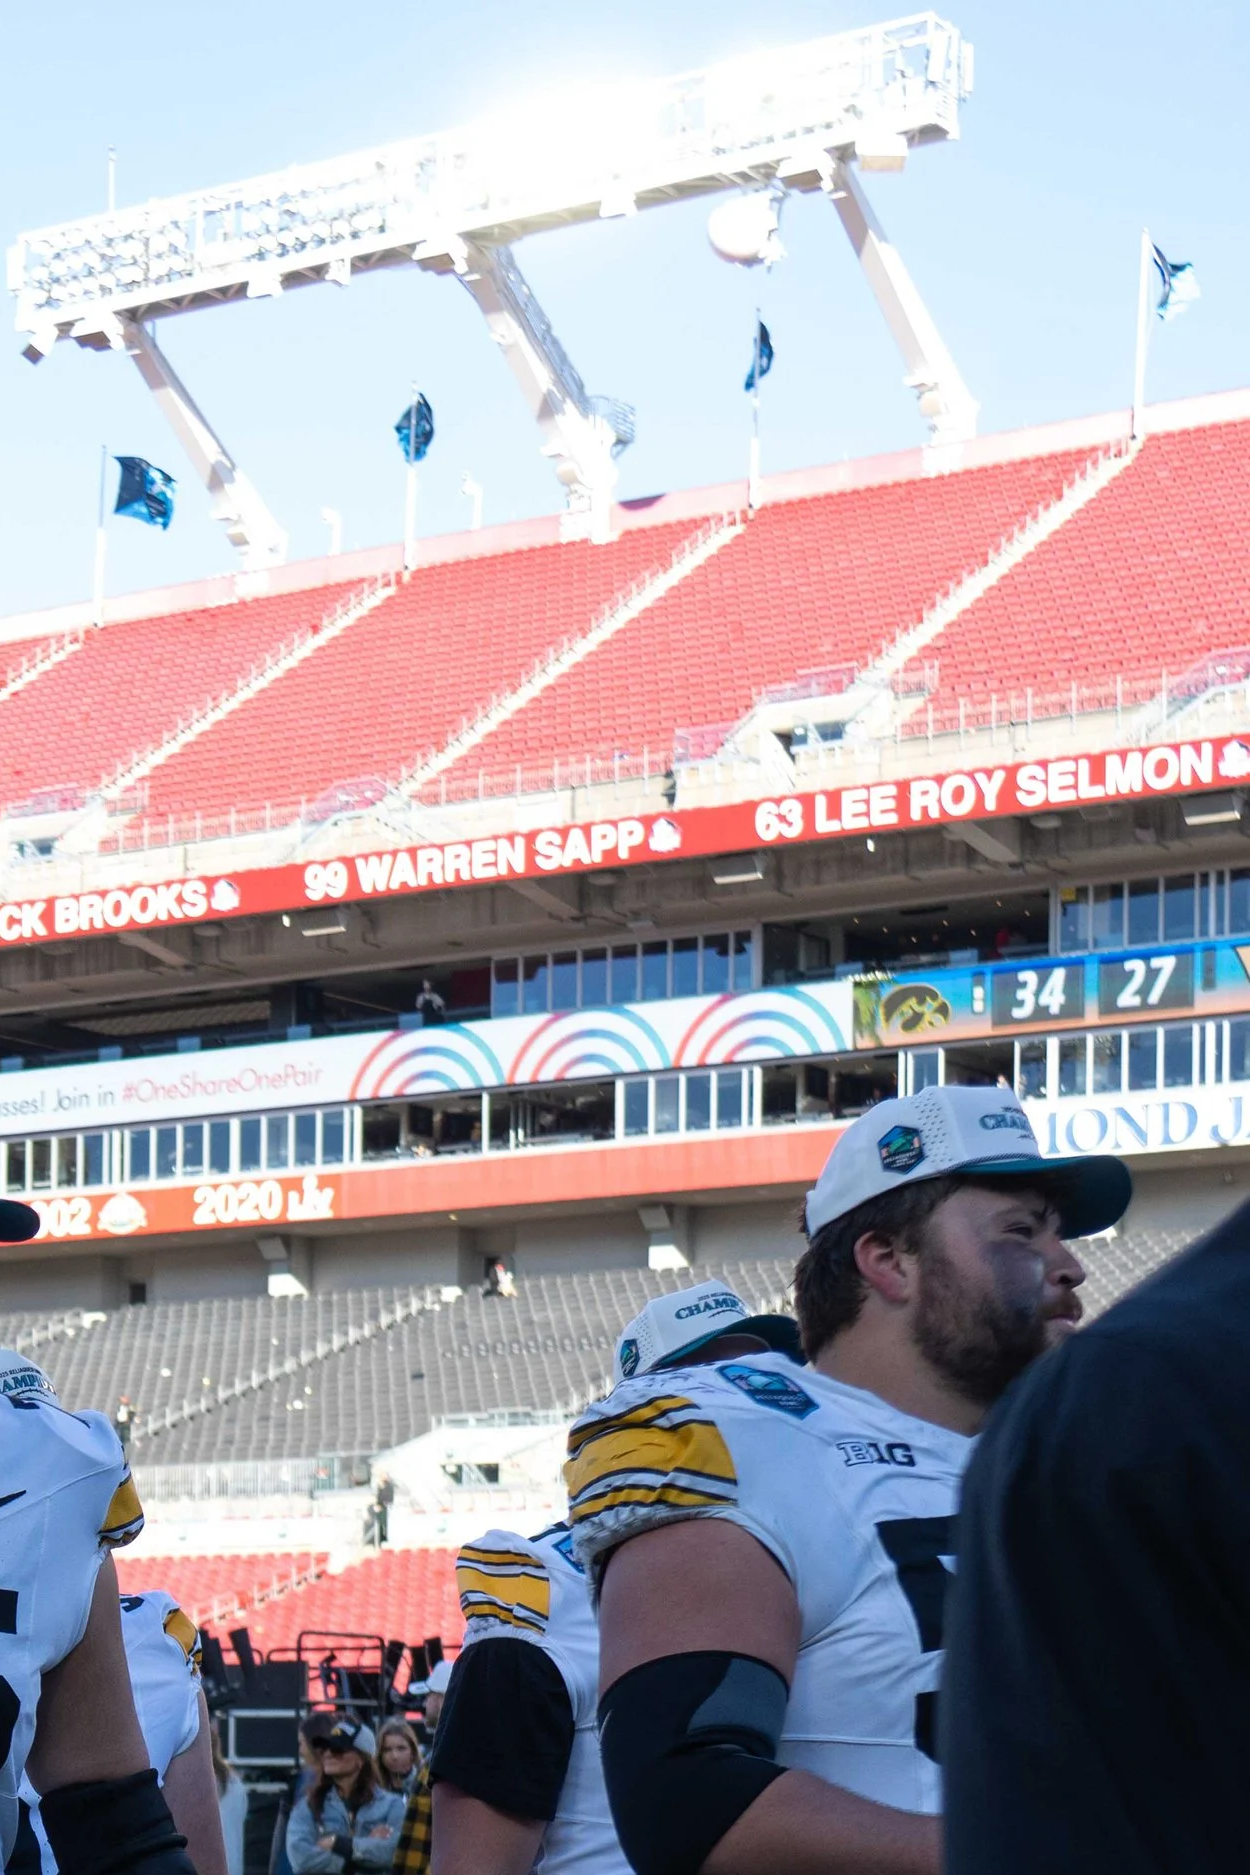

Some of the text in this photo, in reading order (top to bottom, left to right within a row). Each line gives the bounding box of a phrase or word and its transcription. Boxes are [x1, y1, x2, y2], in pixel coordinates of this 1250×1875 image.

[754, 742, 1213, 841] 63 LEE ROY SELMON
[304, 820, 645, 900] 99 WARREN SAPP
[55, 879, 207, 934] BROOKS
[1010, 955, 1176, 1018] 34 27
[53, 1086, 90, 1113] Join
[98, 1085, 115, 1106] in
[122, 1062, 323, 1103] #OneShareOnePair
[1046, 1101, 1198, 1154] OND
[193, 1180, 283, 1225] 2020
